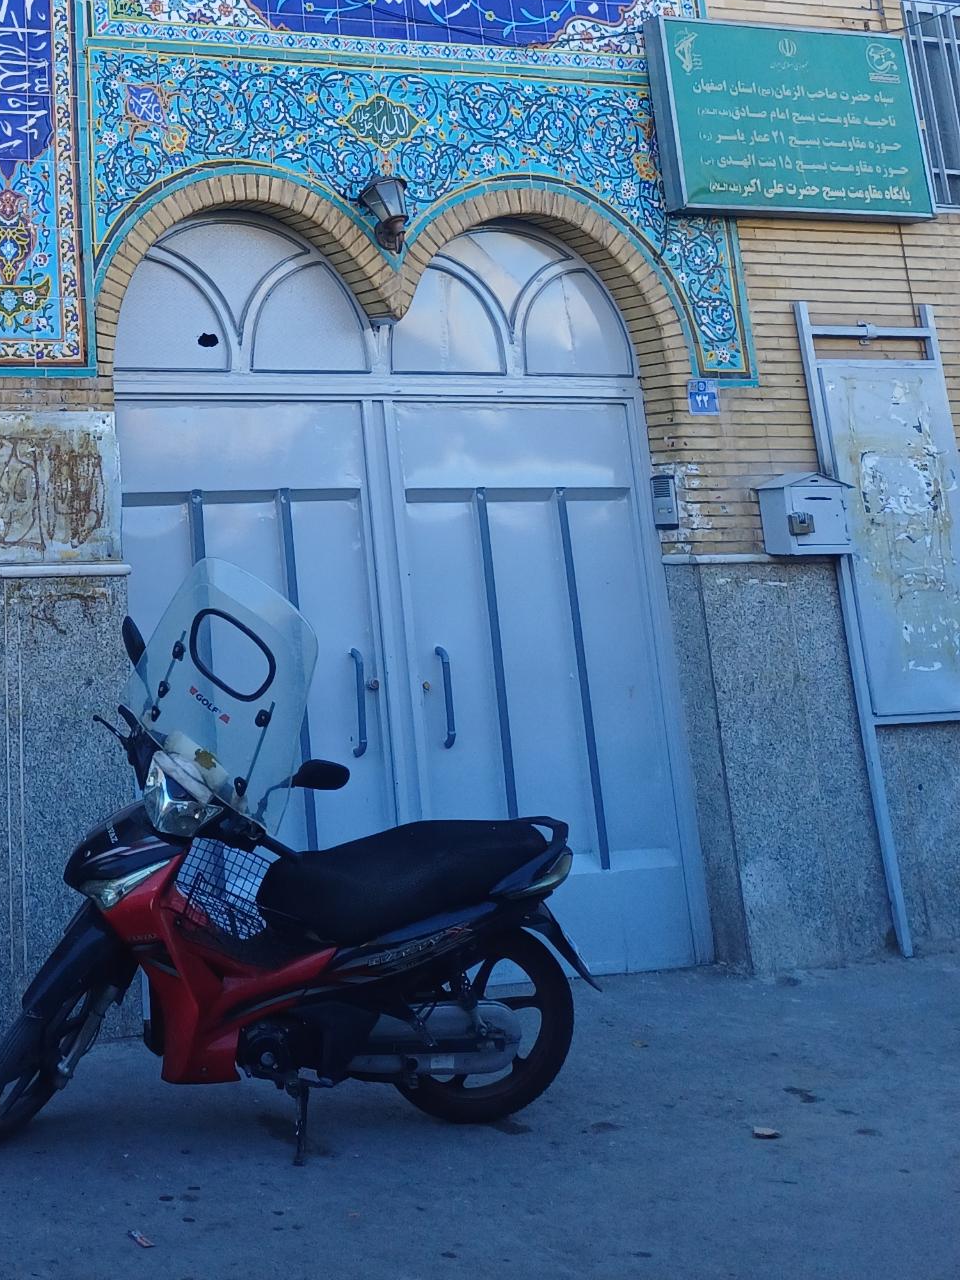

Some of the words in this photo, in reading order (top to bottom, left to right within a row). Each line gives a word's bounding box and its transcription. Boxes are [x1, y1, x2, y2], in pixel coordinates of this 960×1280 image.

[692, 78, 727, 94] اصفهان
[730, 80, 757, 96] استان
[807, 87, 838, 101] صاحب
[840, 90, 871, 105] حضرت
[770, 107, 790, 122] امام
[792, 111, 816, 125] بسیج
[817, 112, 861, 128] مقاومت
[749, 129, 770, 146] عمار
[788, 135, 821, 149] بسیج
[822, 136, 867, 152] مقاومت
[868, 140, 902, 154] حوزه
[795, 159, 828, 174] بسیج
[829, 159, 874, 176] مقاومت
[876, 164, 909, 178] حوزه
[764, 179, 784, 199] علی
[786, 182, 820, 200] حضرت
[822, 184, 847, 201] بسیج
[847, 183, 883, 204] مقاومت
[884, 184, 912, 207] پایگاه
[196, 693, 219, 713] GOLF
